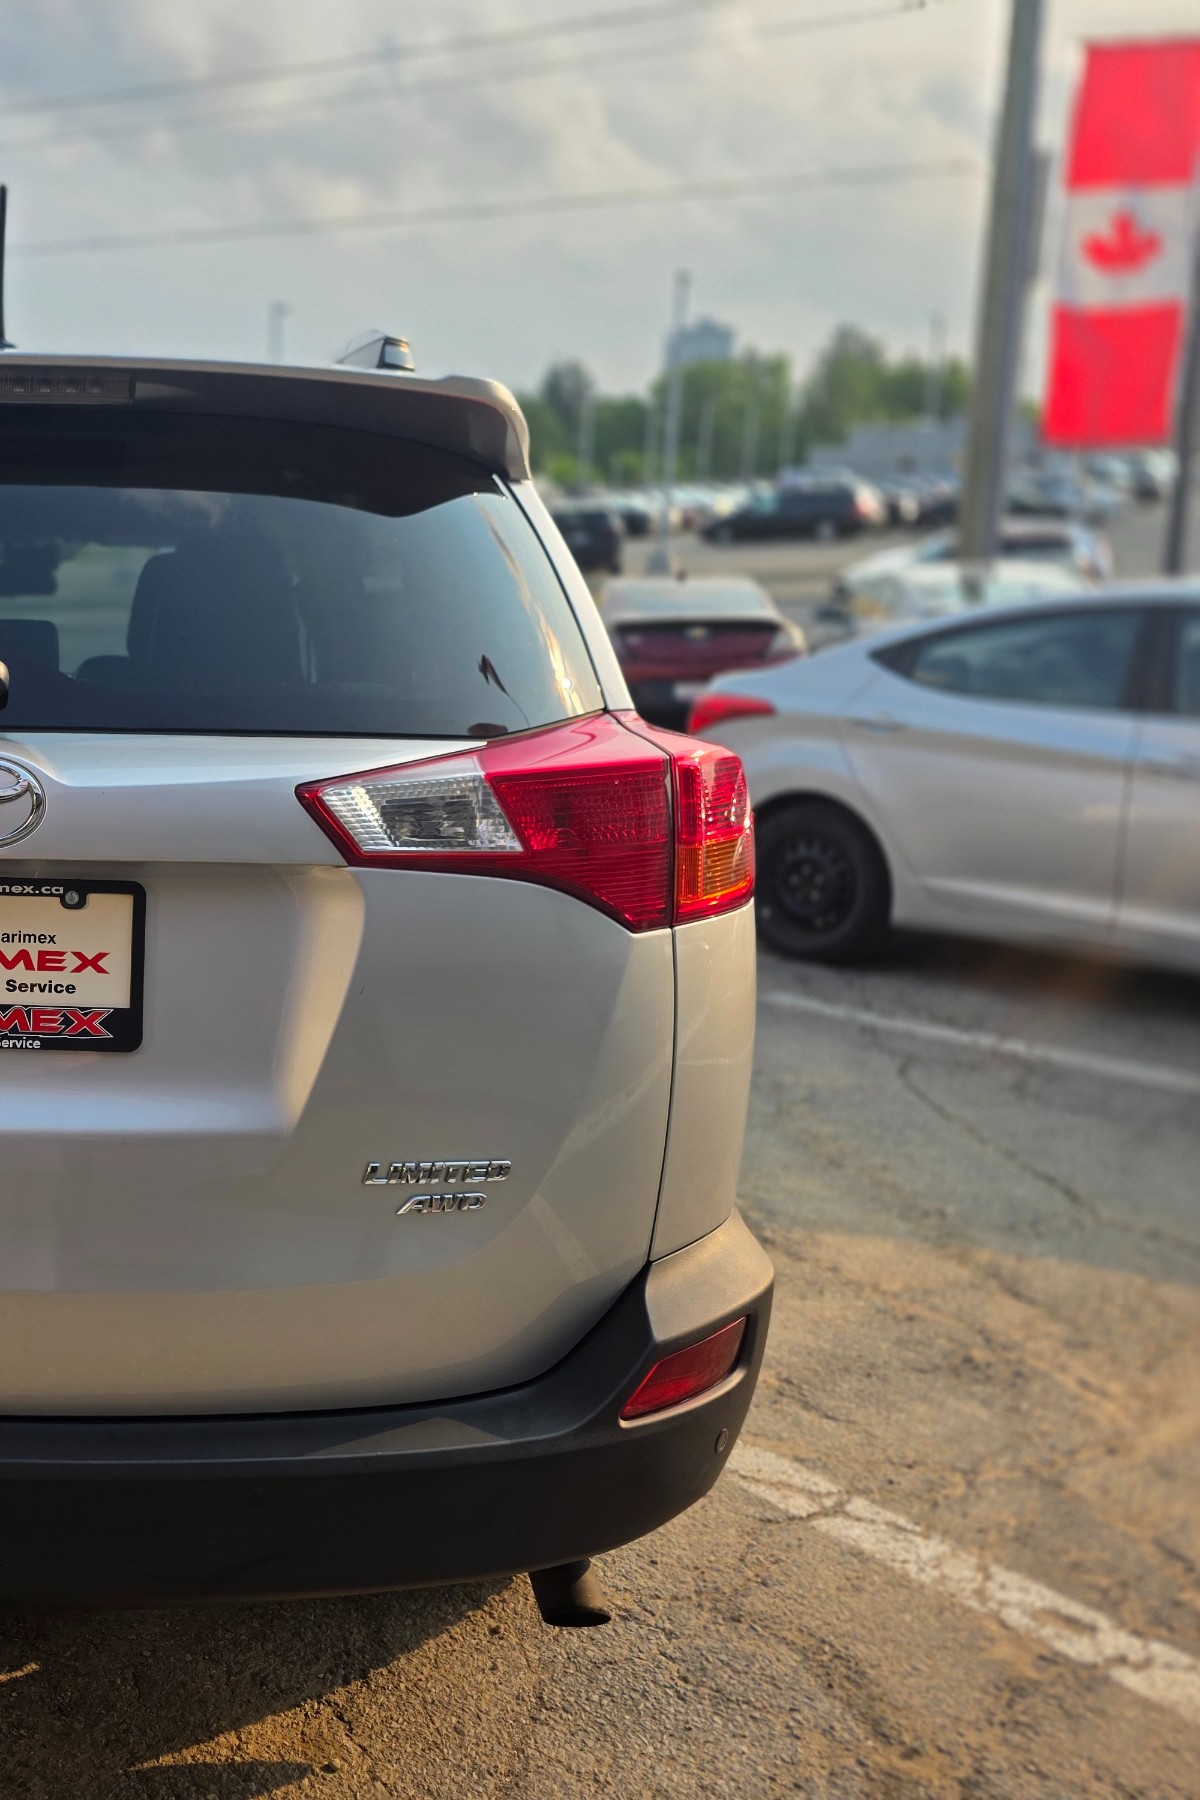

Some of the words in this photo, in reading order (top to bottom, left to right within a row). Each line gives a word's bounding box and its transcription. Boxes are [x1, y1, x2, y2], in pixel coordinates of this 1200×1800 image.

[5, 979, 77, 994] Service
[363, 1160, 512, 1185] LIMITED
[396, 1192, 487, 1215] AWD
